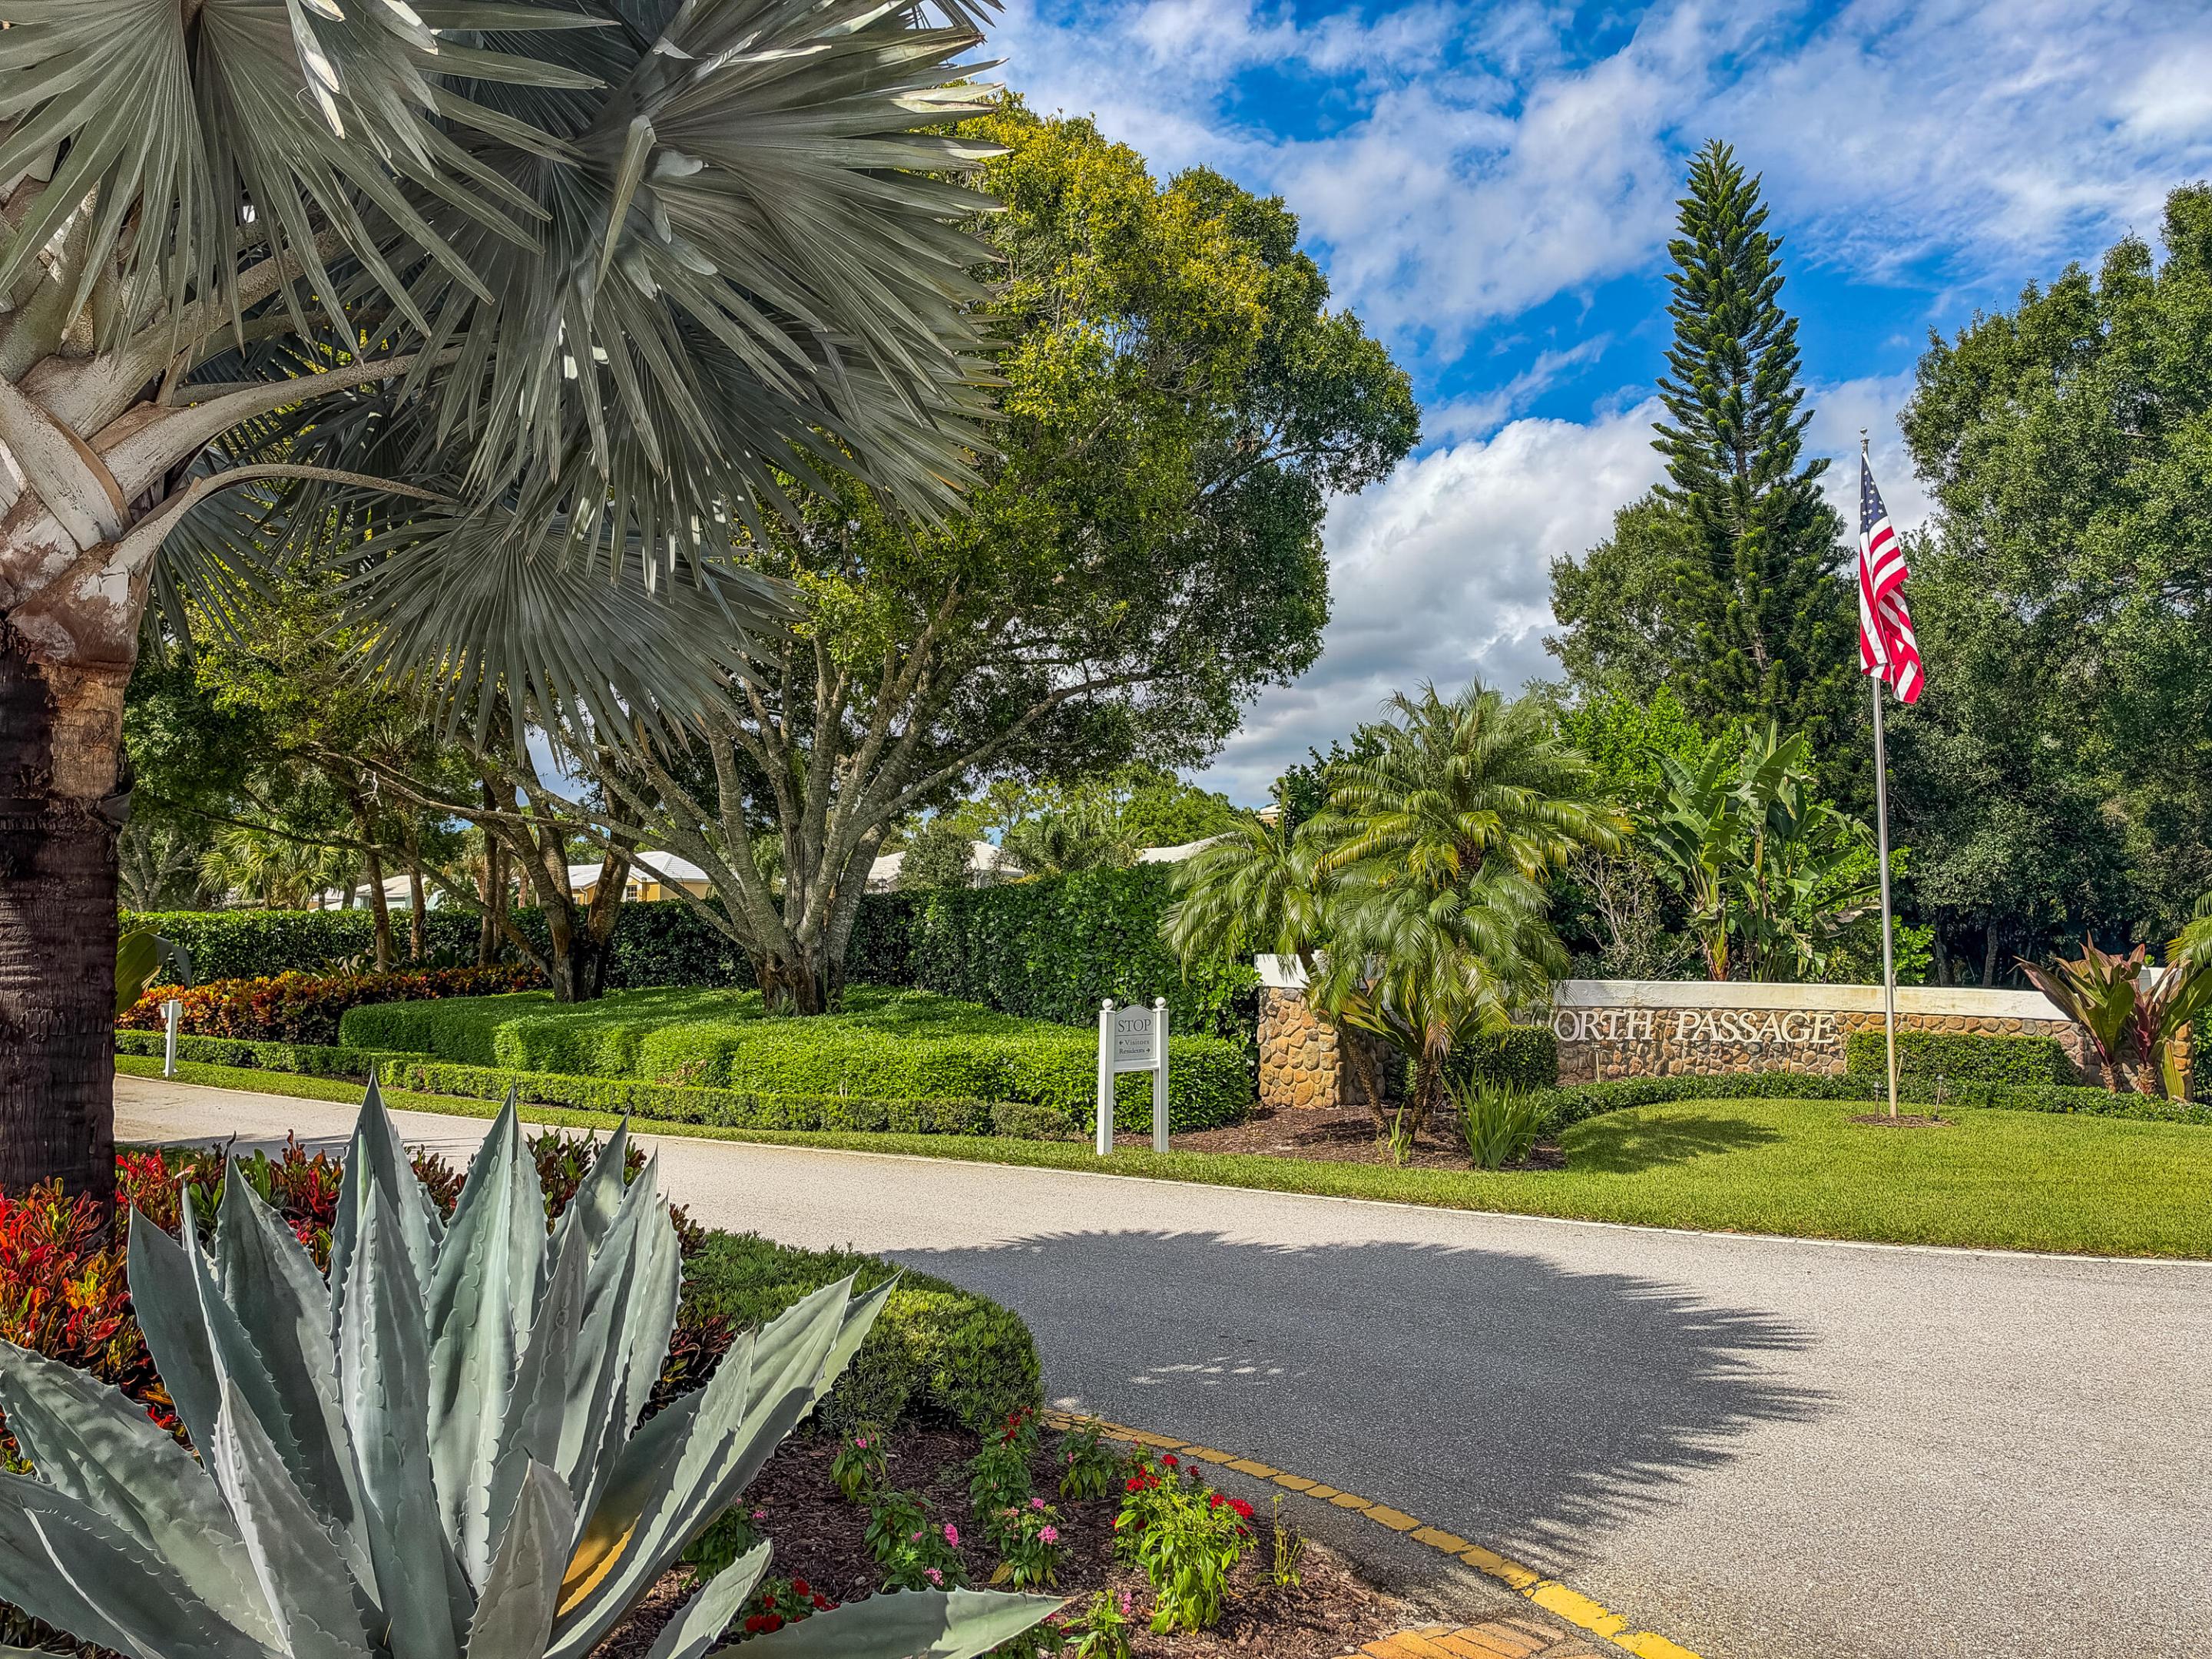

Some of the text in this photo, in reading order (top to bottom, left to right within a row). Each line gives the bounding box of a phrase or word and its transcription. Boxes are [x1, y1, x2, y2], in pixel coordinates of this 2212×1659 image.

[1118, 1019, 1151, 1032] STOP
[1530, 1009, 1835, 1043] ORTH PASSAGE
